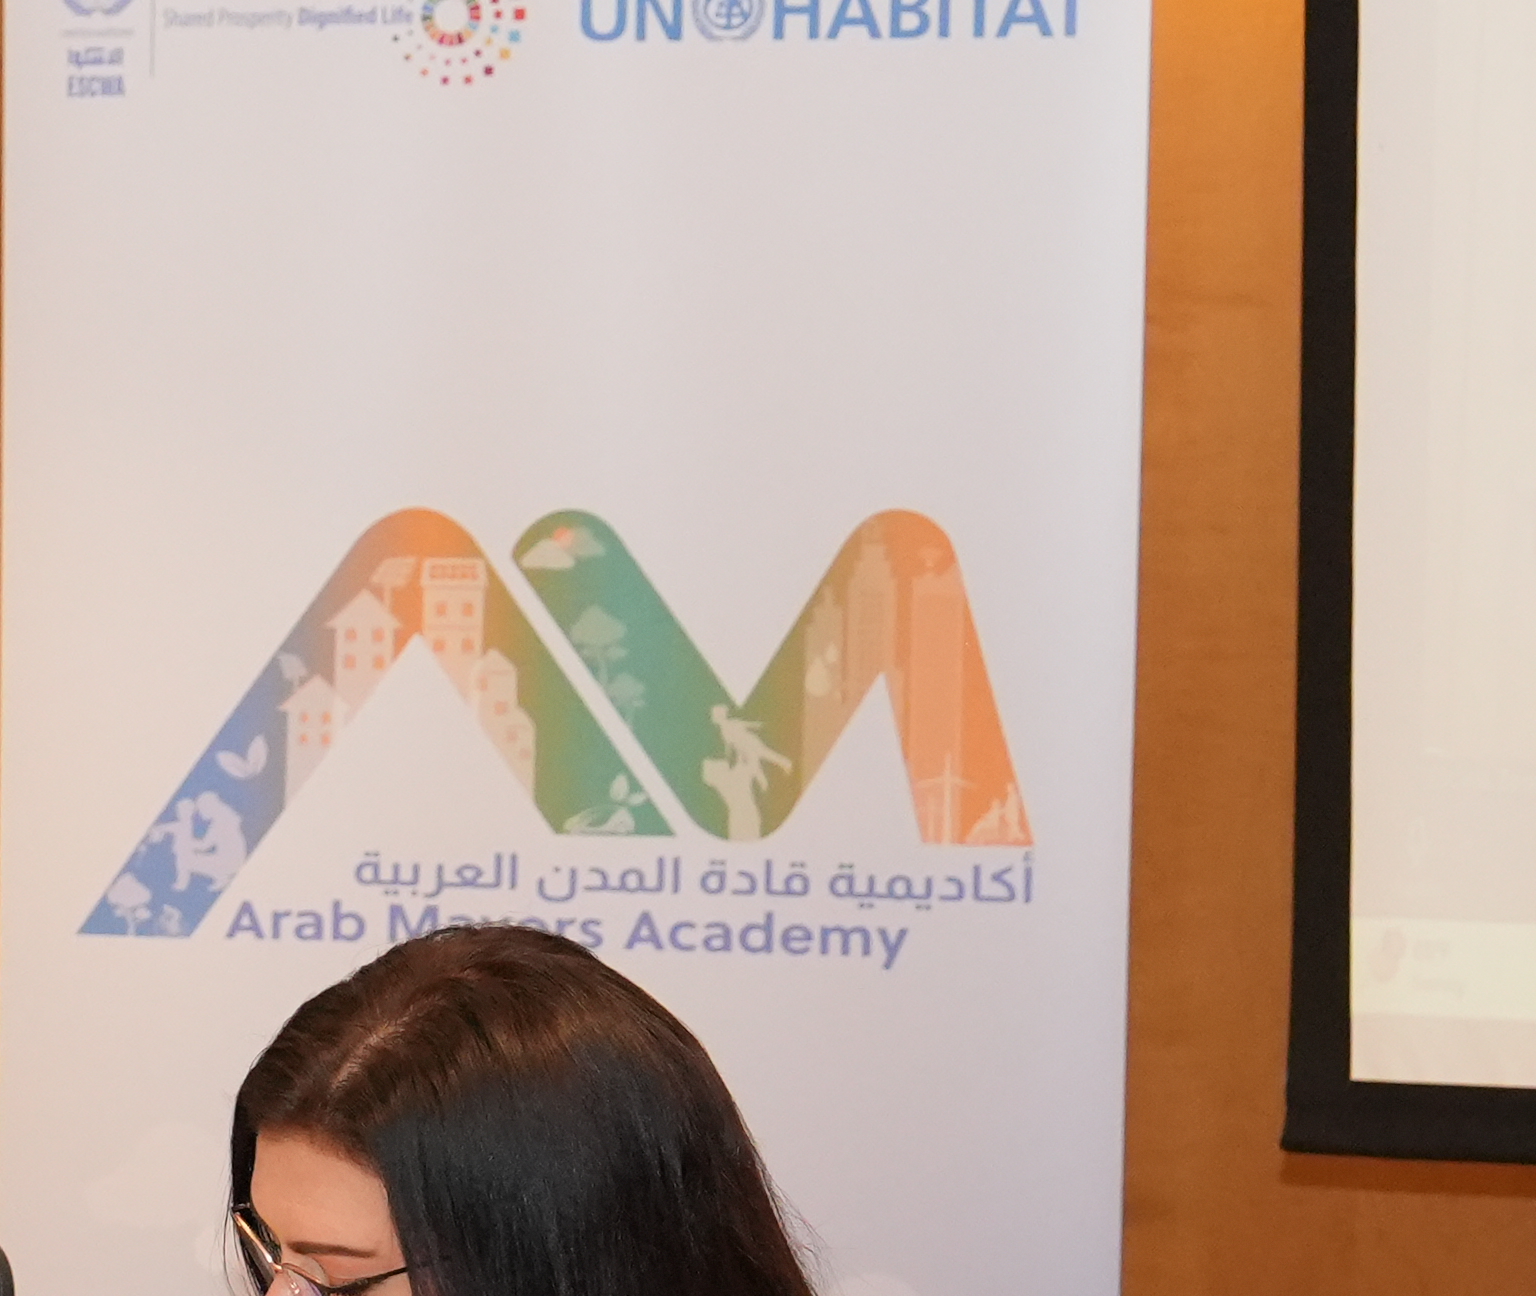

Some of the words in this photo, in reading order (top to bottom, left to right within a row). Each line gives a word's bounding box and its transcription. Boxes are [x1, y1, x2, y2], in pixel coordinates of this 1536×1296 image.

[578, 0, 683, 42] UN
[354, 851, 518, 899] العربية
[537, 856, 681, 904] المدن
[699, 858, 811, 898] قادة
[828, 851, 1033, 911] أكاديمية
[225, 899, 367, 943] Arab
[623, 911, 909, 971] Academy
